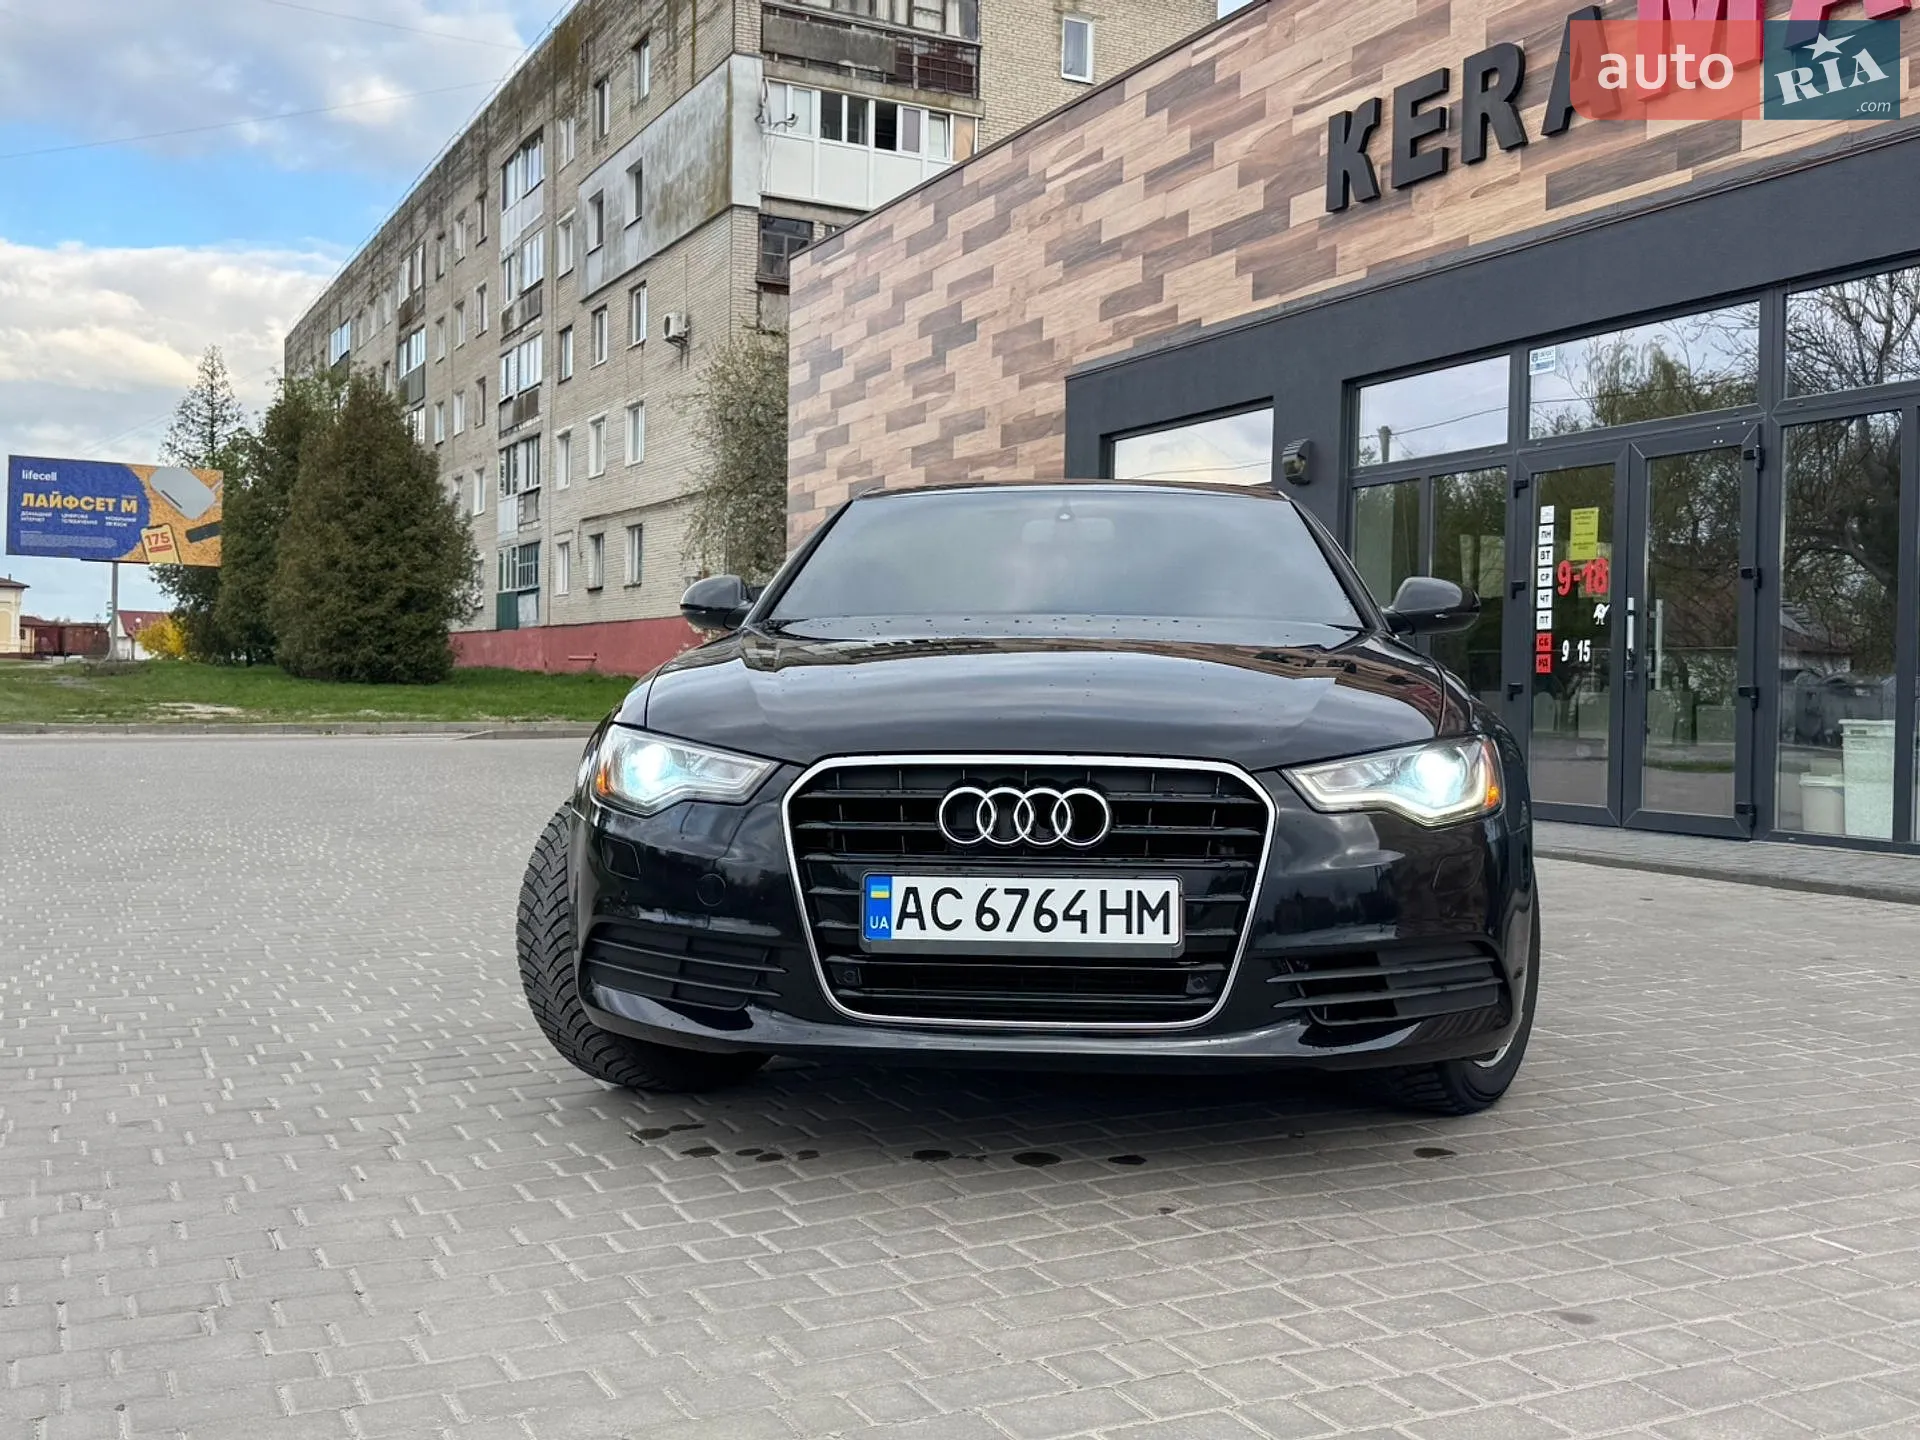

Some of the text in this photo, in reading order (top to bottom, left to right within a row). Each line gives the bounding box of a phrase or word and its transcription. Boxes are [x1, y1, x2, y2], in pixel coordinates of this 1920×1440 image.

[22, 470, 57, 481] lifecell
[21, 491, 116, 512] ЛАЙФСЕТ
[145, 531, 171, 546] 175
[1561, 639, 1591, 662] 9 15
[896, 886, 1170, 935] AC 6764 HM
[870, 915, 889, 929] UA
